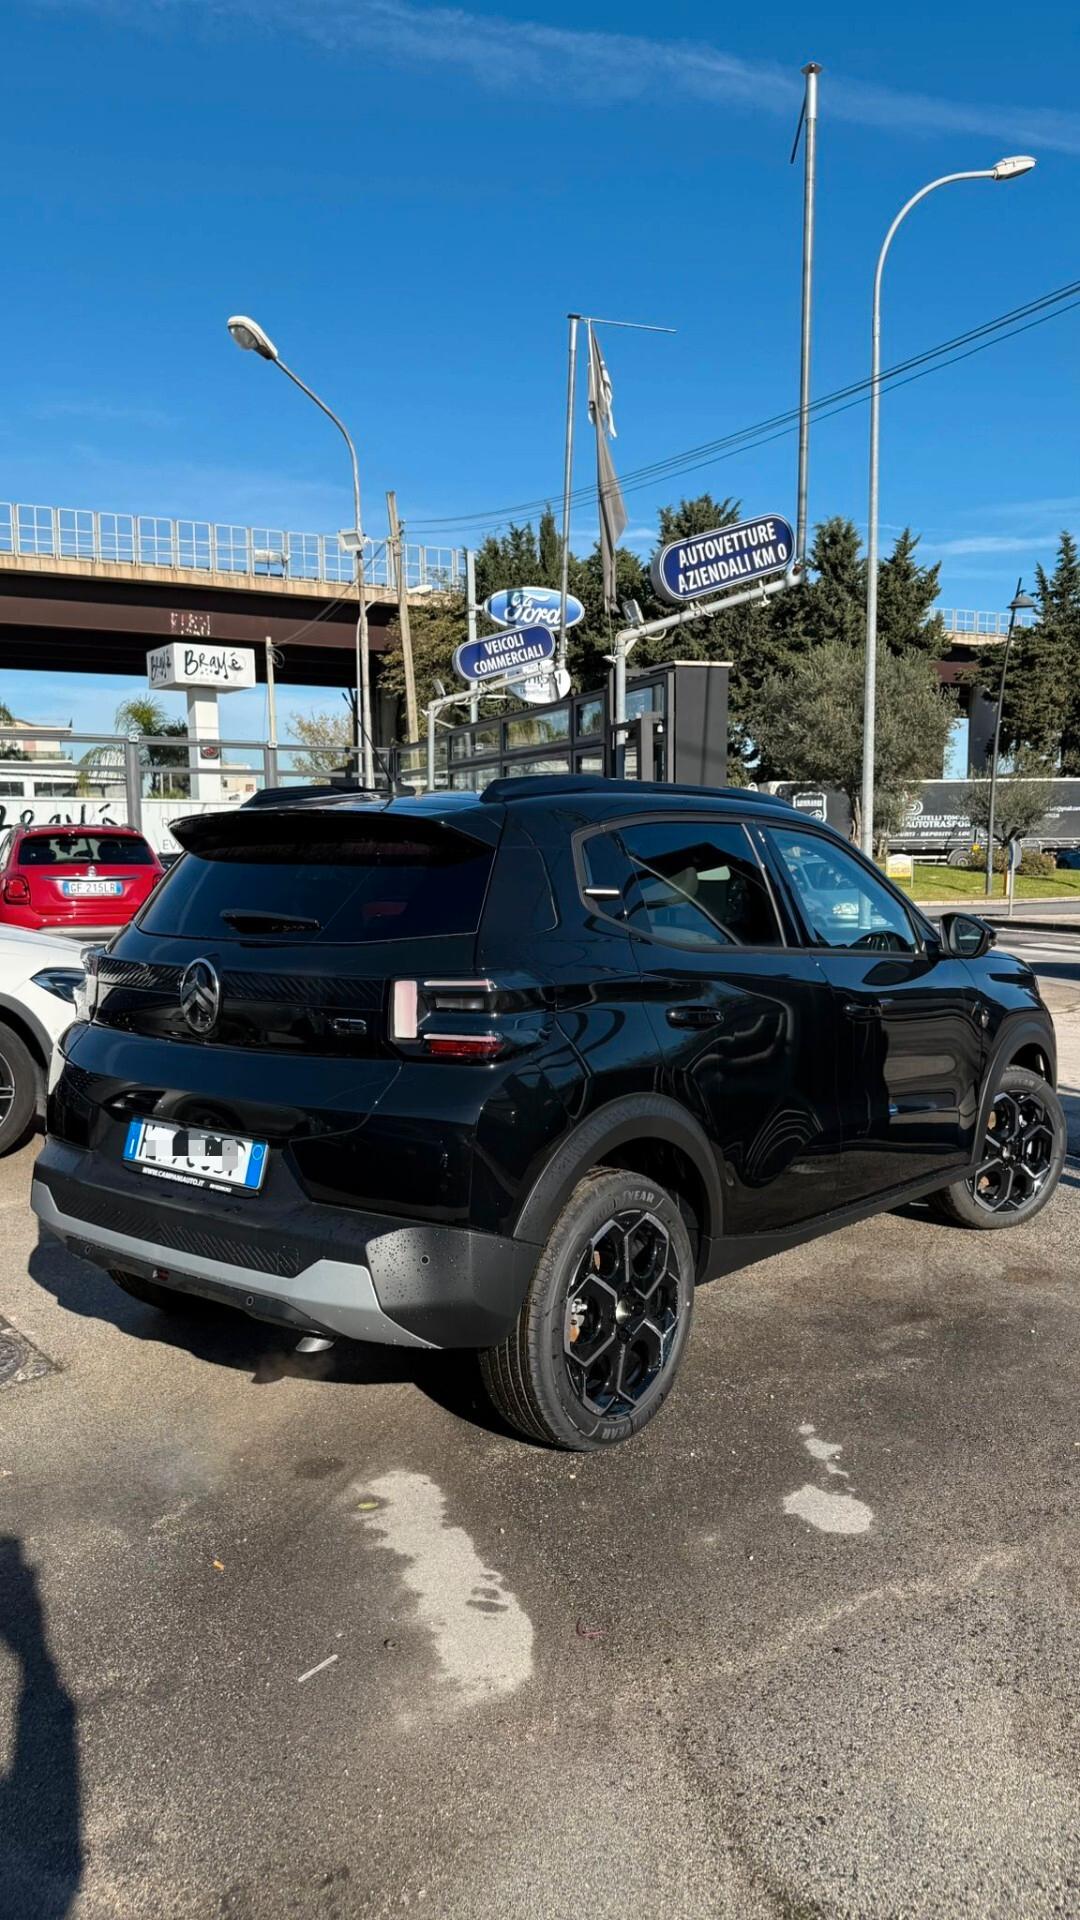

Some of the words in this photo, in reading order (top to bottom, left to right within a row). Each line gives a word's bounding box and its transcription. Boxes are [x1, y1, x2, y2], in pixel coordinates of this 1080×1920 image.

[679, 521, 777, 569] AUTOVETTURE
[677, 555, 751, 593] AZIENDALI
[752, 547, 776, 569] KM
[503, 591, 562, 625] Ford
[473, 643, 544, 674] COMMERCIALI
[484, 632, 524, 655] VEICOLI
